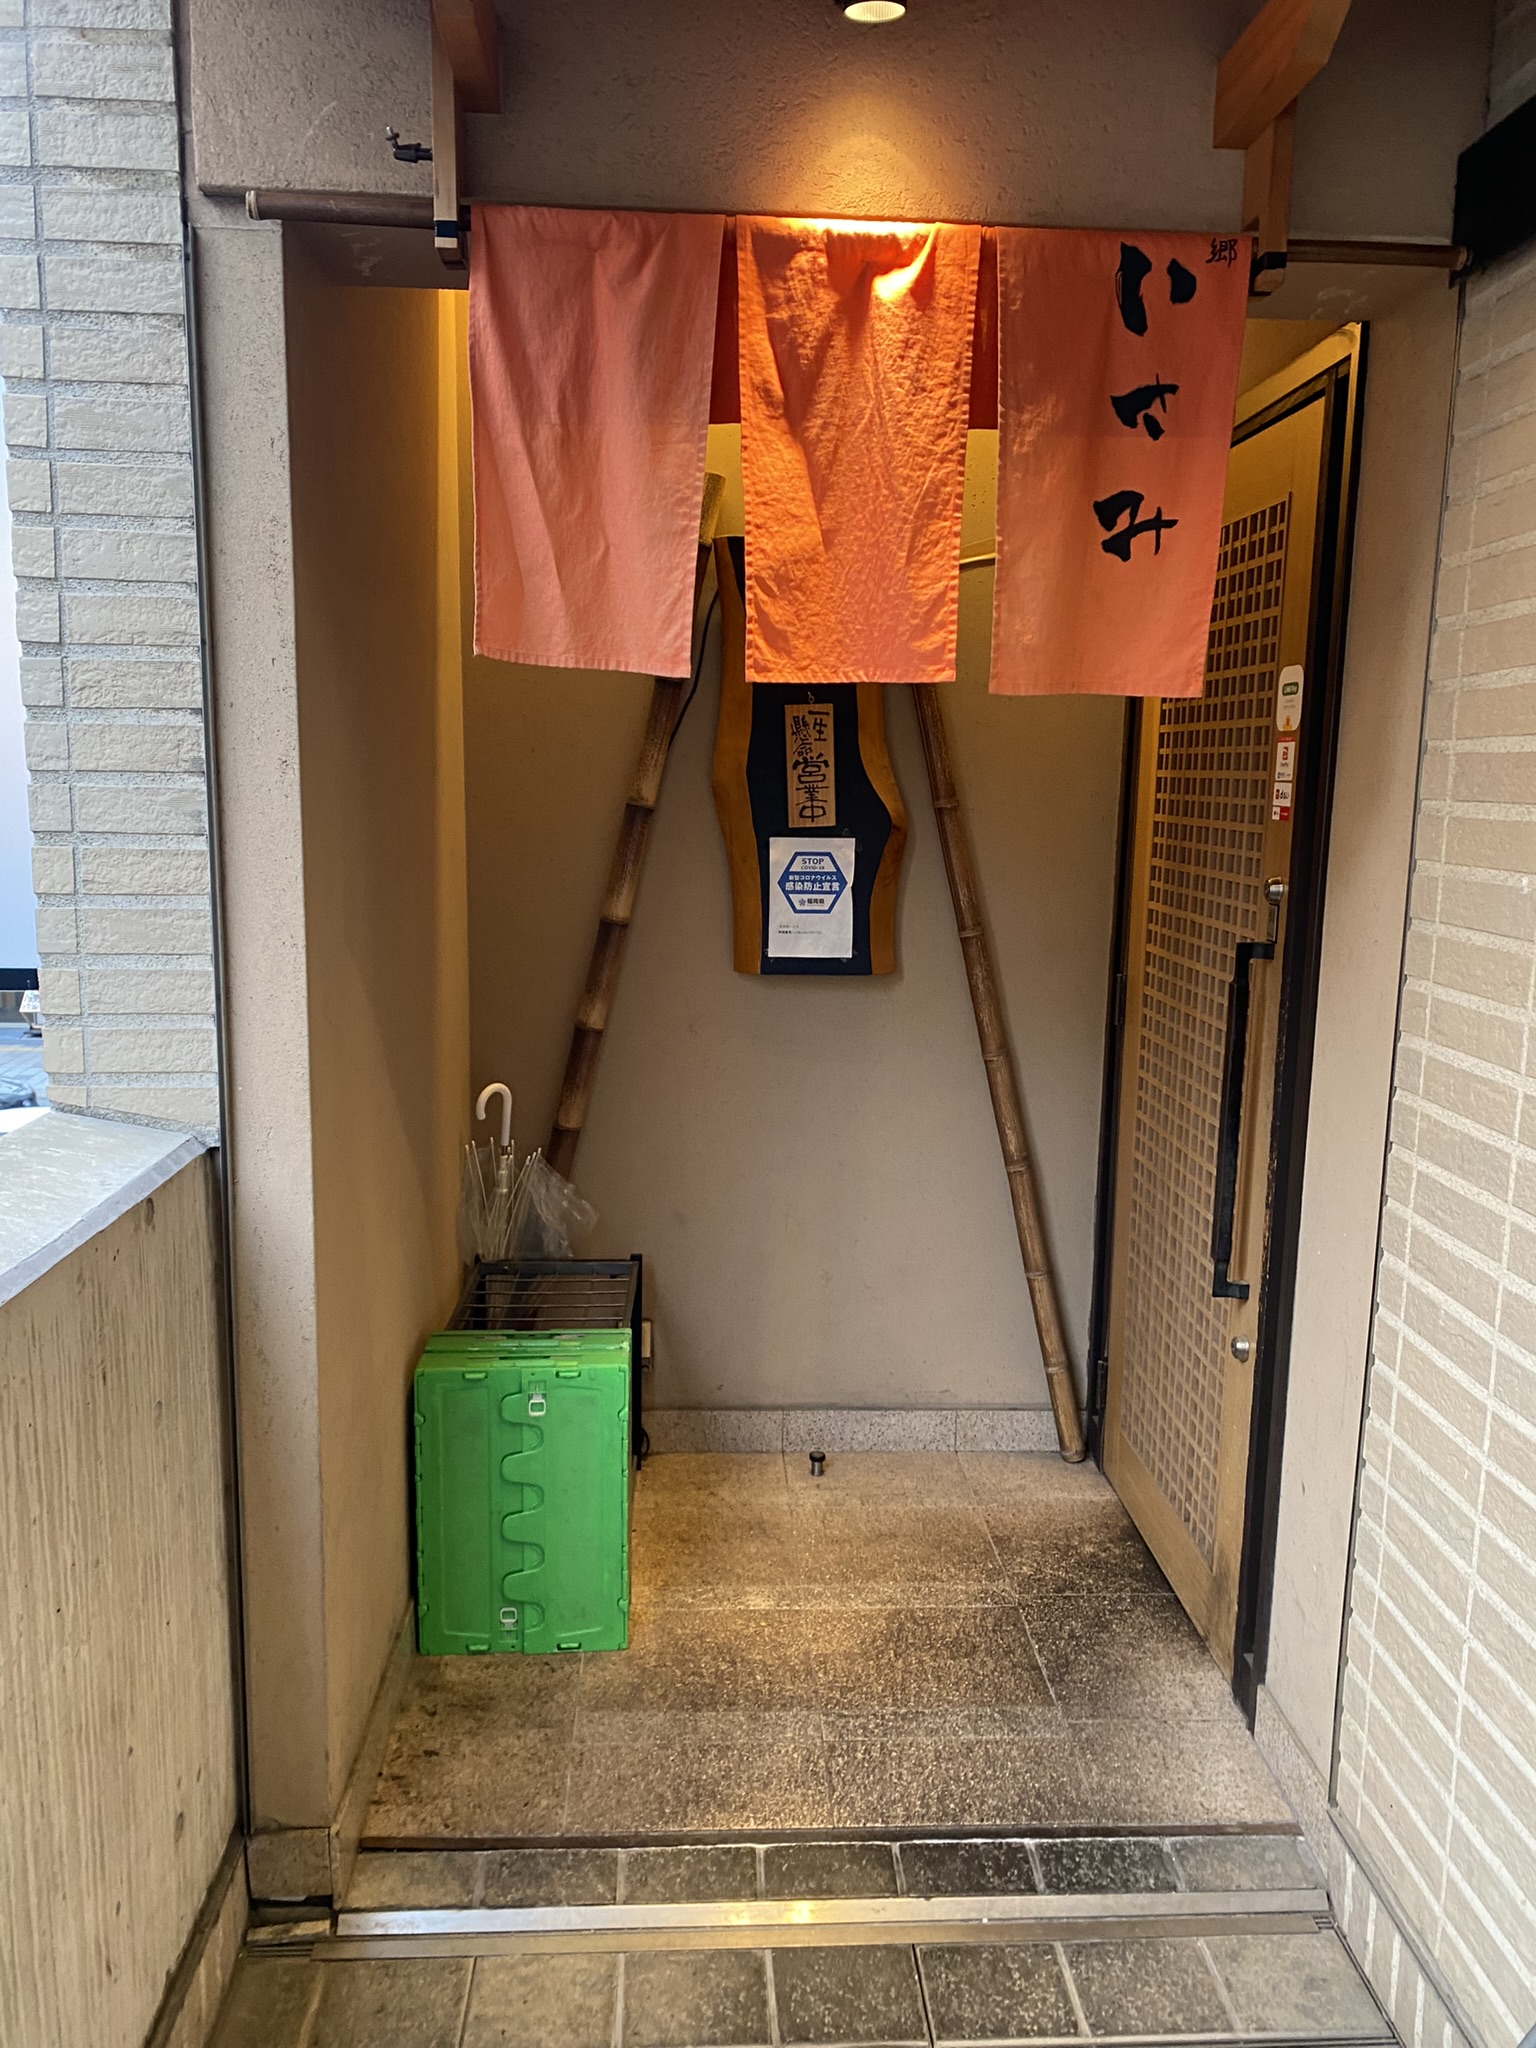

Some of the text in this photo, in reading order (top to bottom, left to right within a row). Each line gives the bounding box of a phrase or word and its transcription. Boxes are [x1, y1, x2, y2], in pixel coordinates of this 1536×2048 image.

[1205, 237, 1239, 268] 郷
[1092, 241, 1197, 562] いさみ
[792, 752, 830, 823] 営業中
[801, 857, 825, 865] STOP
[785, 881, 841, 892] 感染防止宣言
